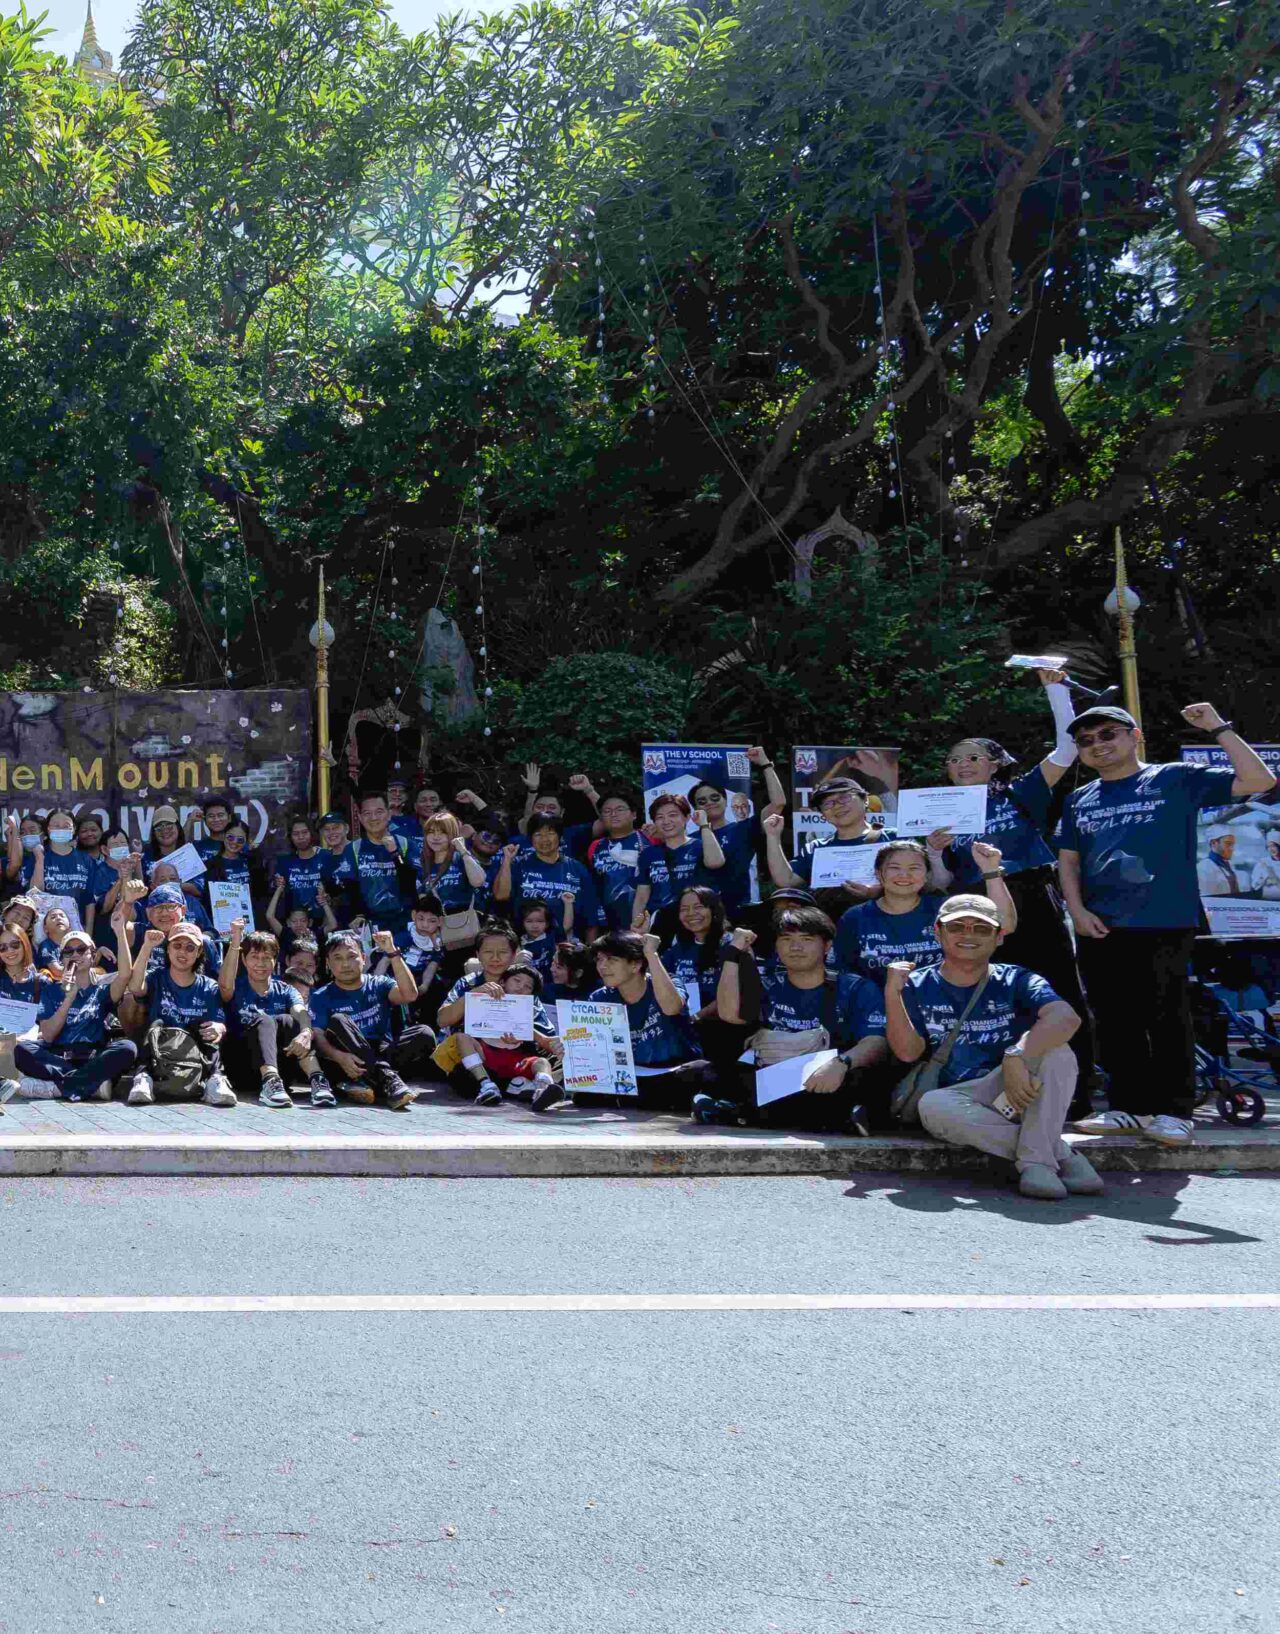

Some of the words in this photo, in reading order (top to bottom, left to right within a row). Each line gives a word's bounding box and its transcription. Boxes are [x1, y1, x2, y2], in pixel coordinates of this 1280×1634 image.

[665, 750, 681, 758] THE
[682, 750, 688, 758] V
[689, 751, 723, 759] SCHOOL
[571, 1015, 613, 1026] N.MONLY
[565, 1074, 598, 1085] MAKING
